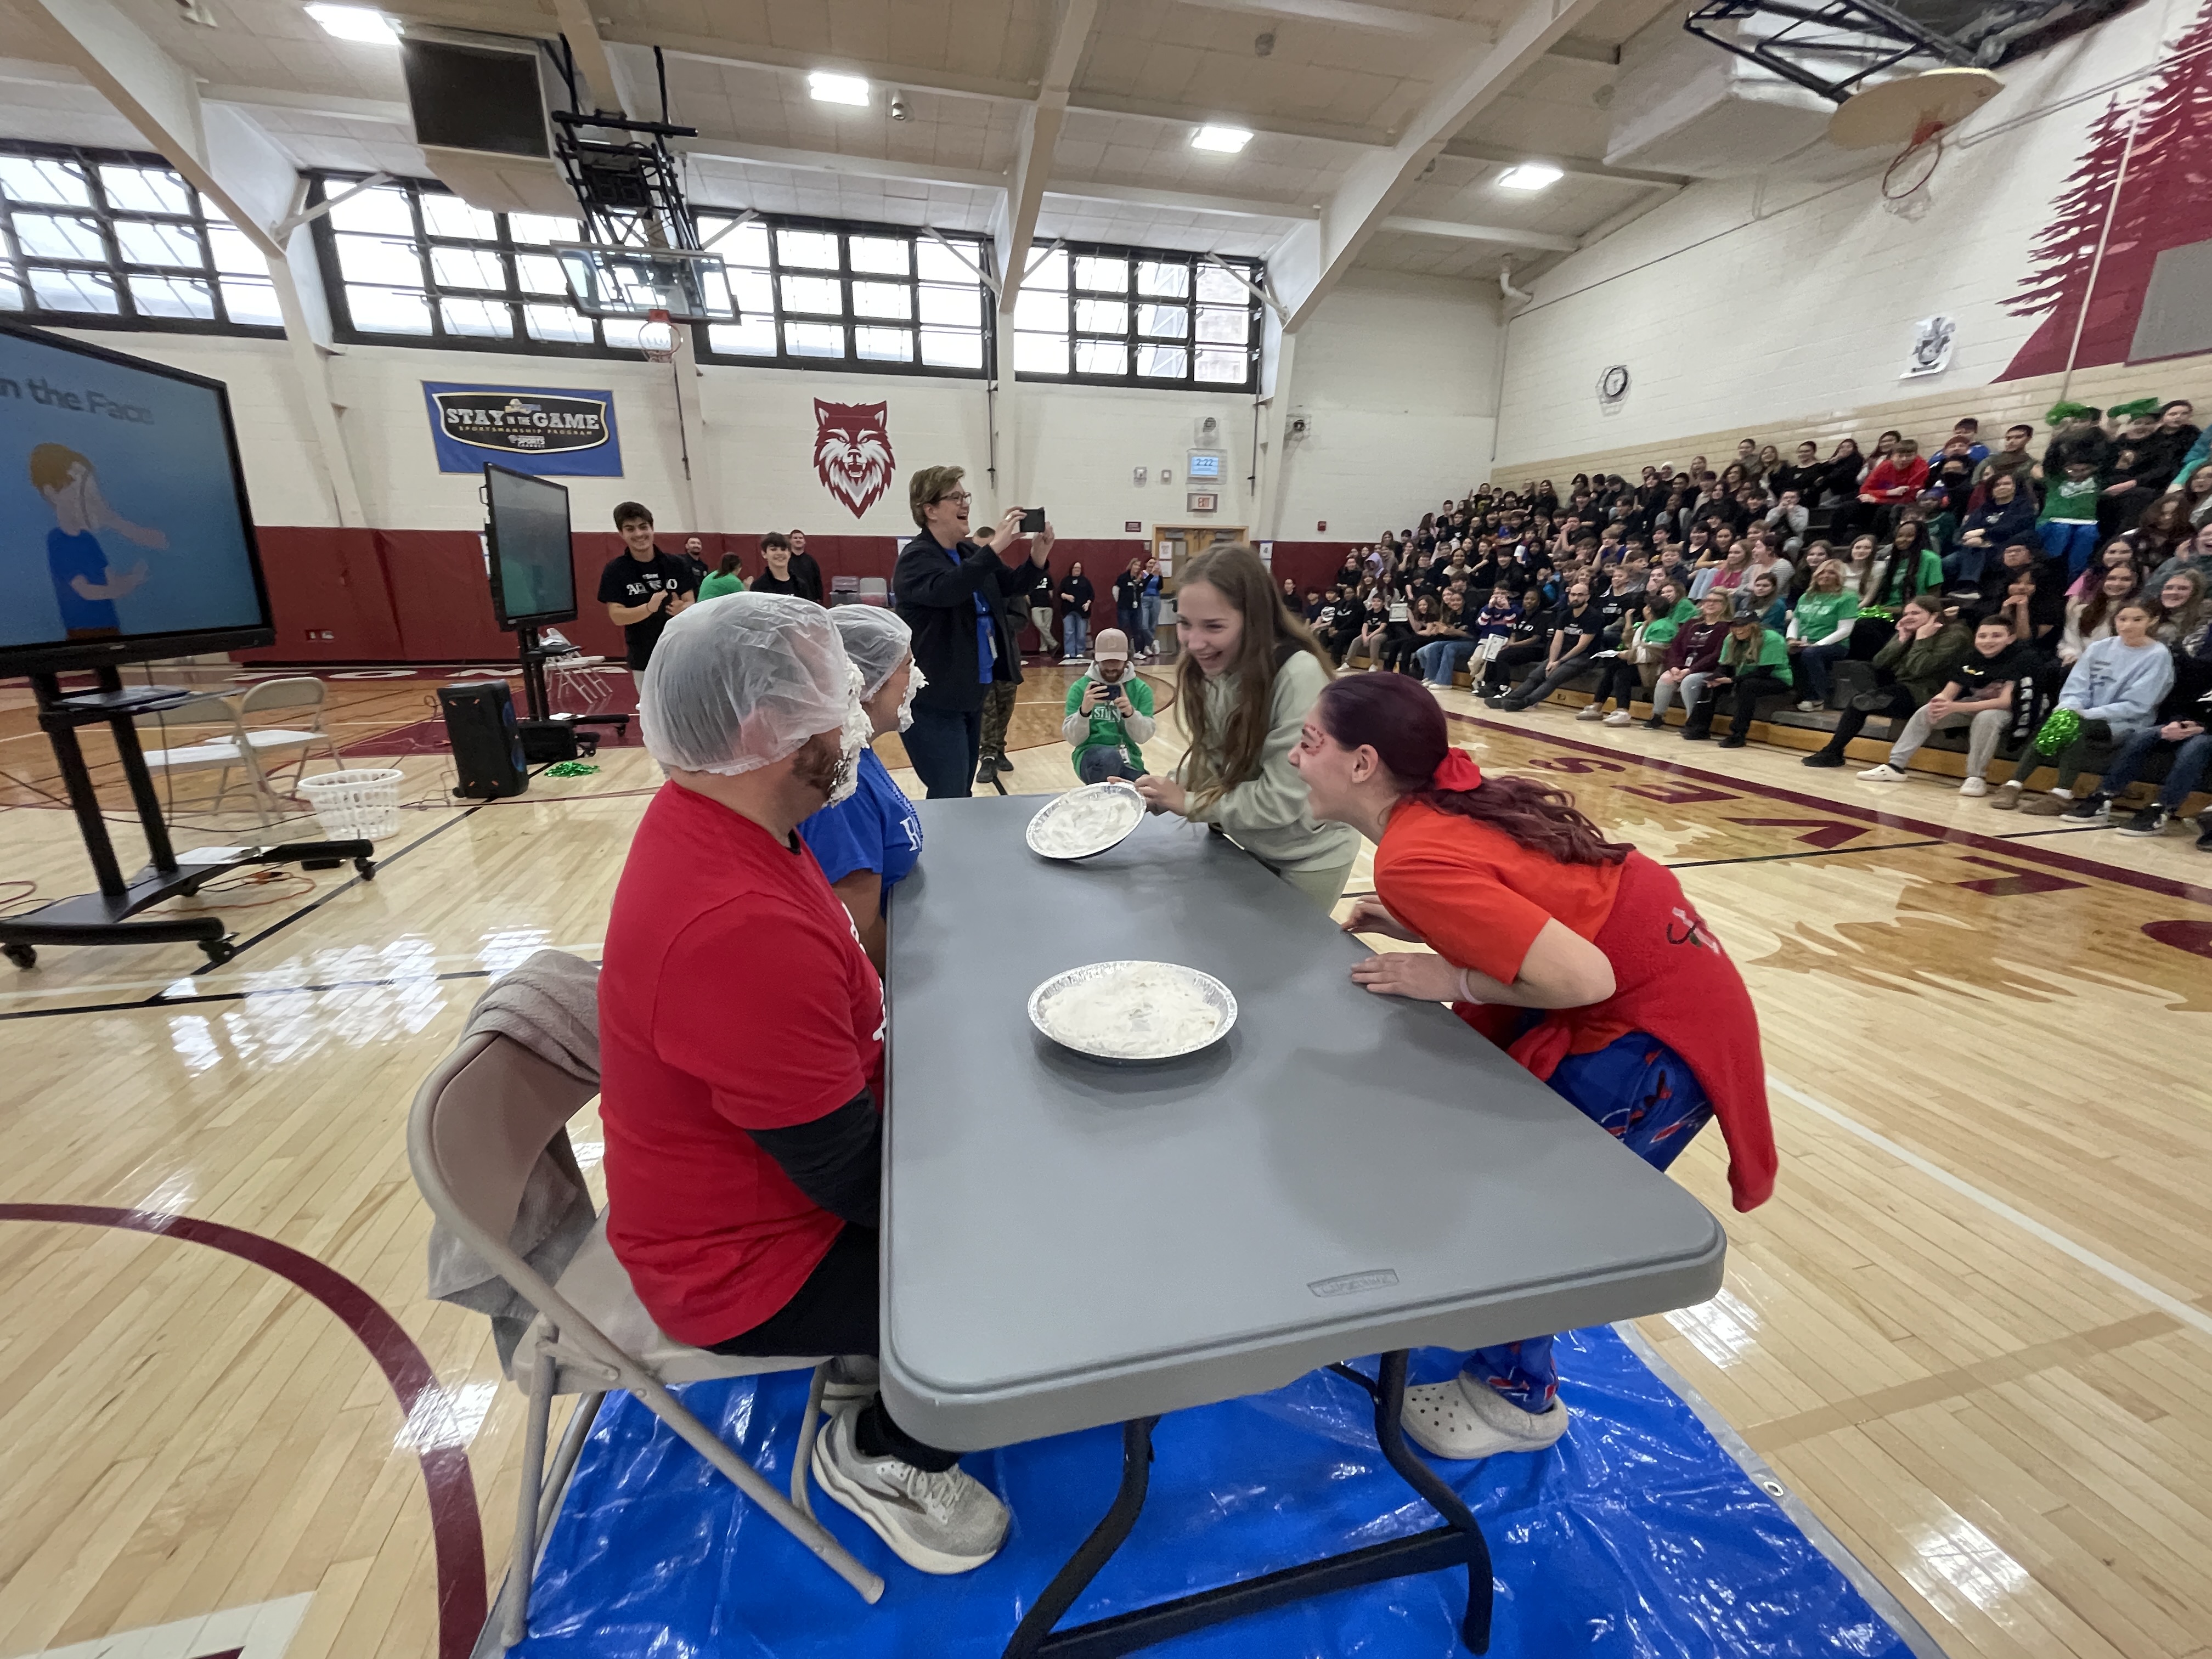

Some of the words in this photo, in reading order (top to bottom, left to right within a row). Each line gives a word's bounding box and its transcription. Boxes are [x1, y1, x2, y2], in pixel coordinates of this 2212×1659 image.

[26, 376, 83, 412] the
[446, 408, 505, 426] STAY
[533, 412, 600, 430] GAME
[459, 425, 542, 435] SPORTSMANSHIP
